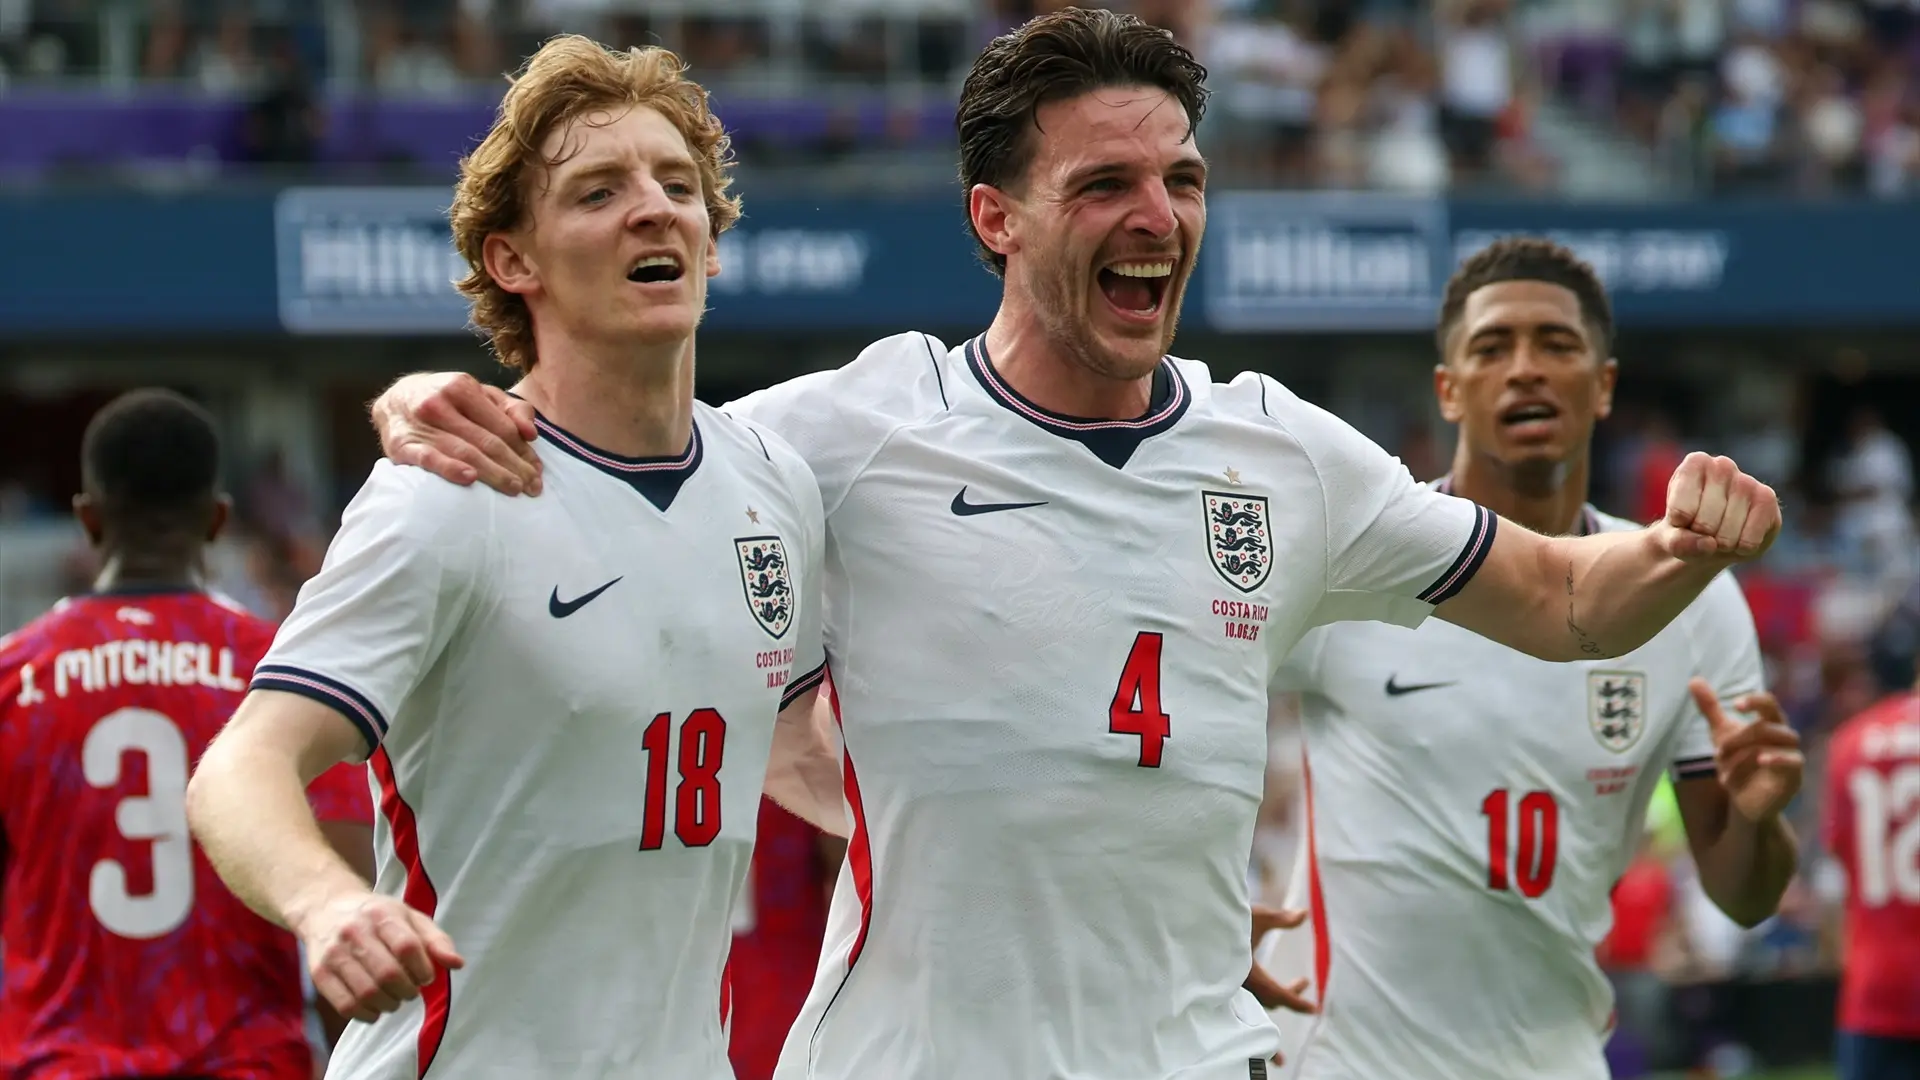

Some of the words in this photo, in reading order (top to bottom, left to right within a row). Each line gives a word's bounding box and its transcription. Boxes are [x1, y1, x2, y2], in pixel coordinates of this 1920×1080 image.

[1212, 599, 1250, 619] COSTA
[1252, 604, 1269, 622] RICA
[1225, 621, 1260, 641] 10.06.26
[55, 639, 245, 698] MITCHELL
[756, 650, 781, 668] COSTA
[1109, 631, 1171, 768] 4
[639, 707, 726, 851] 18
[82, 706, 194, 939] 3
[1481, 788, 1558, 898] 10
